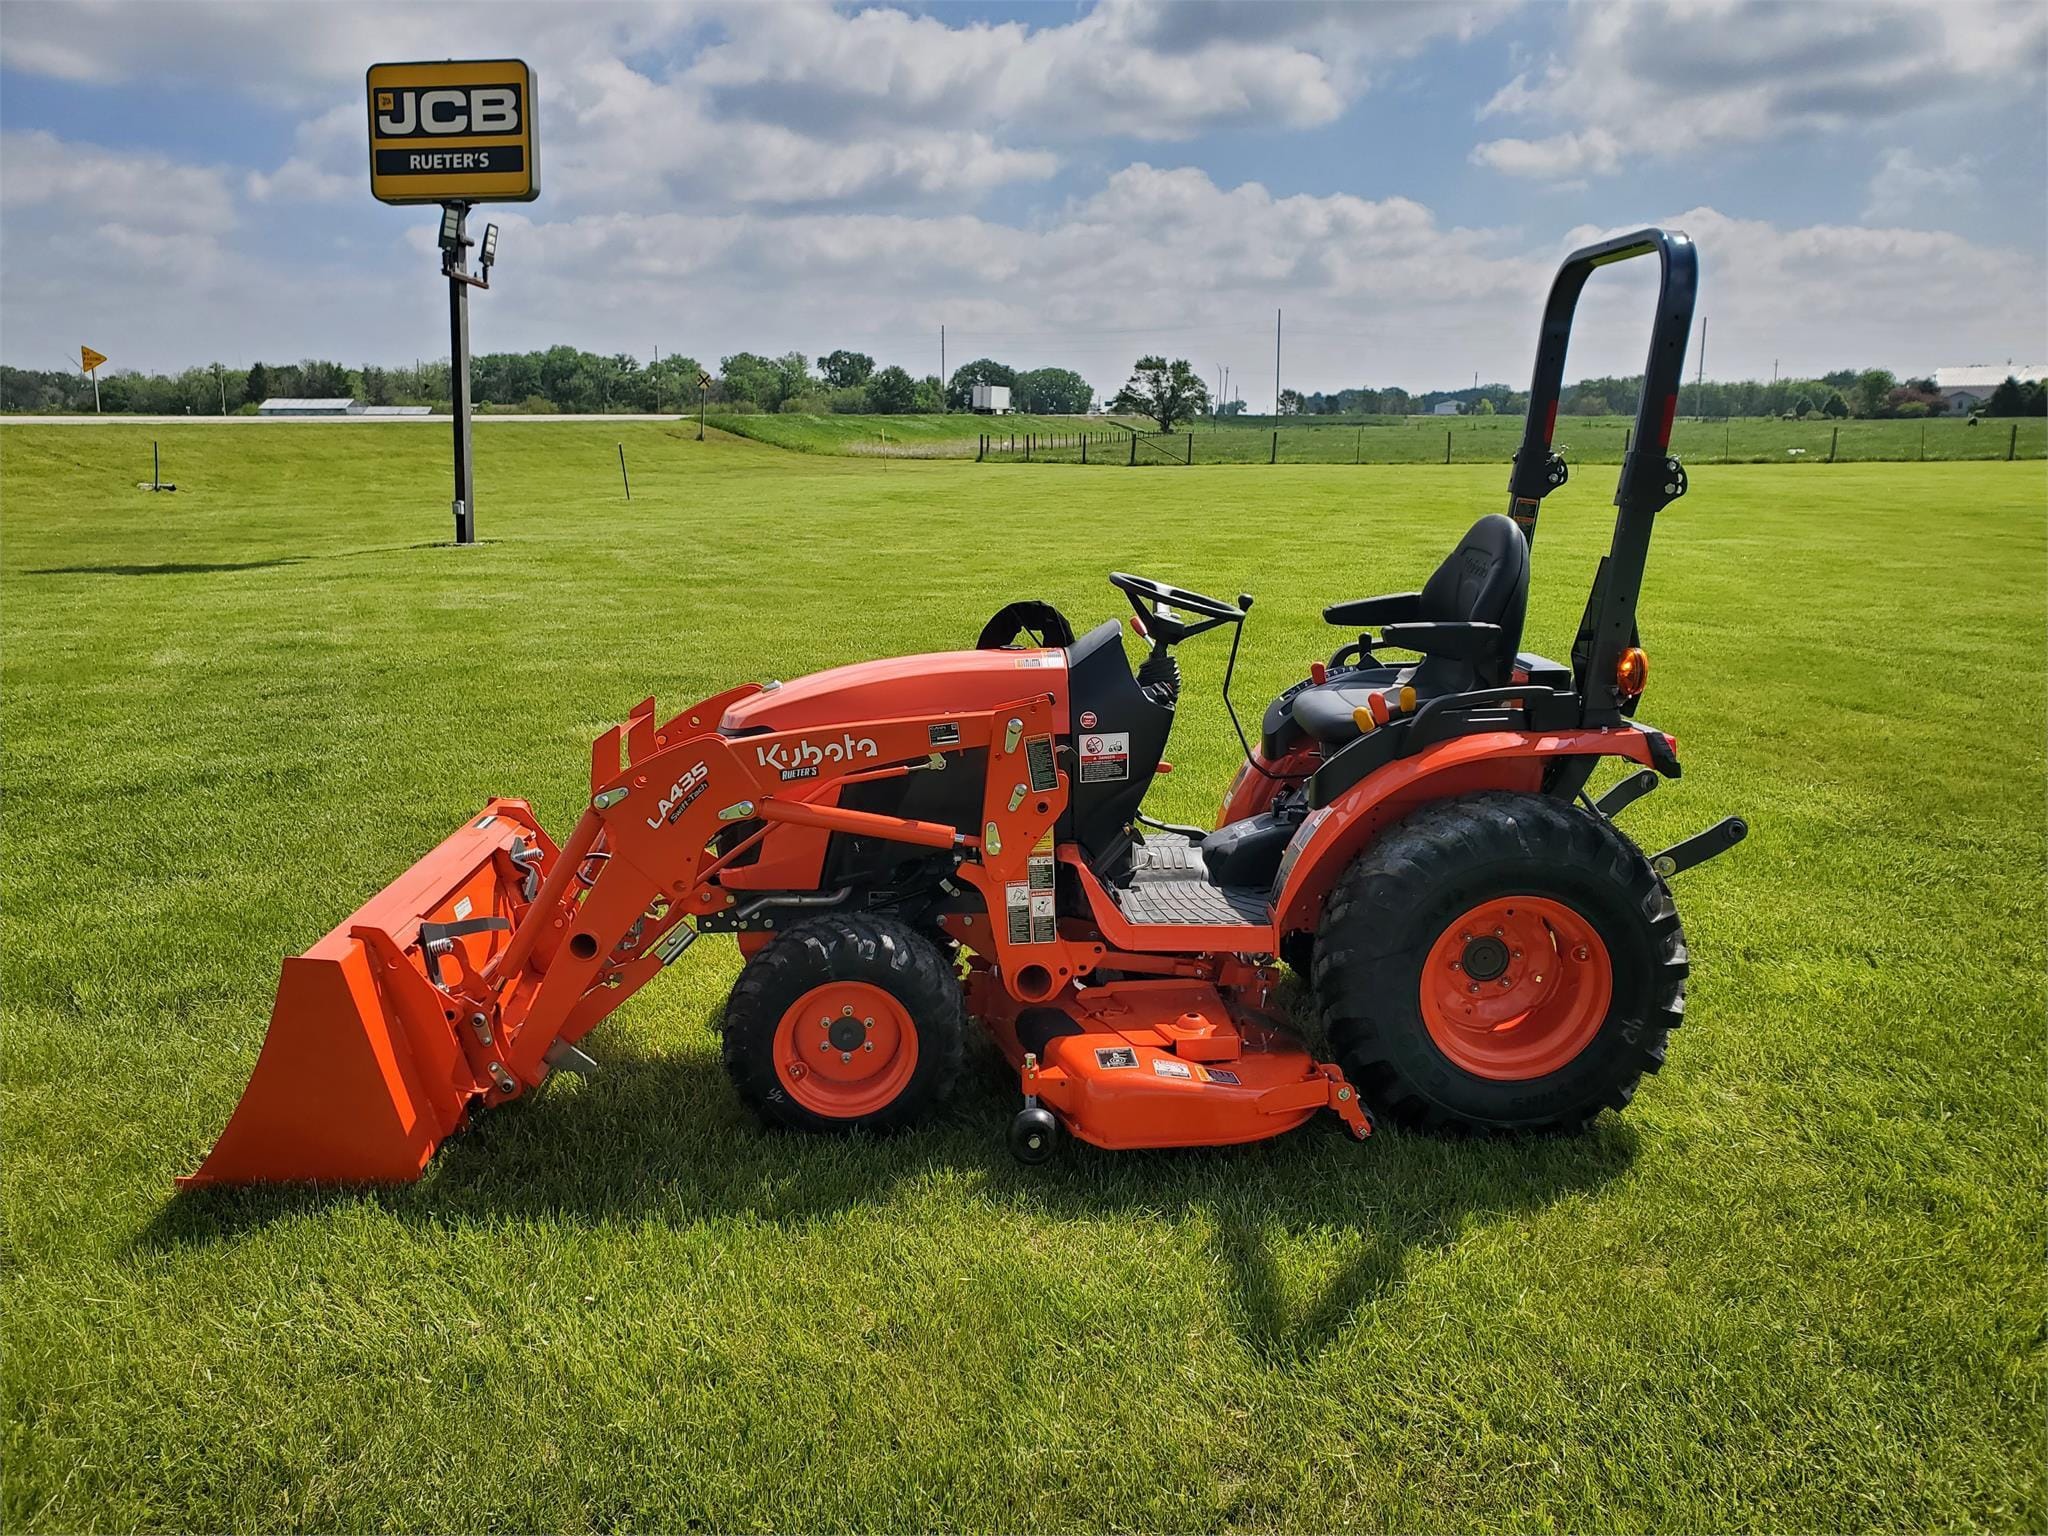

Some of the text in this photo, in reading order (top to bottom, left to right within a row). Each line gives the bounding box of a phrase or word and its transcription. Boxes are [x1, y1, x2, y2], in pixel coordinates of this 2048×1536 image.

[378, 88, 519, 135] JCB
[409, 152, 490, 170] RUETER'S
[756, 733, 878, 770] Kubota
[782, 766, 817, 780] RUETER'S
[646, 760, 708, 829] LA435
